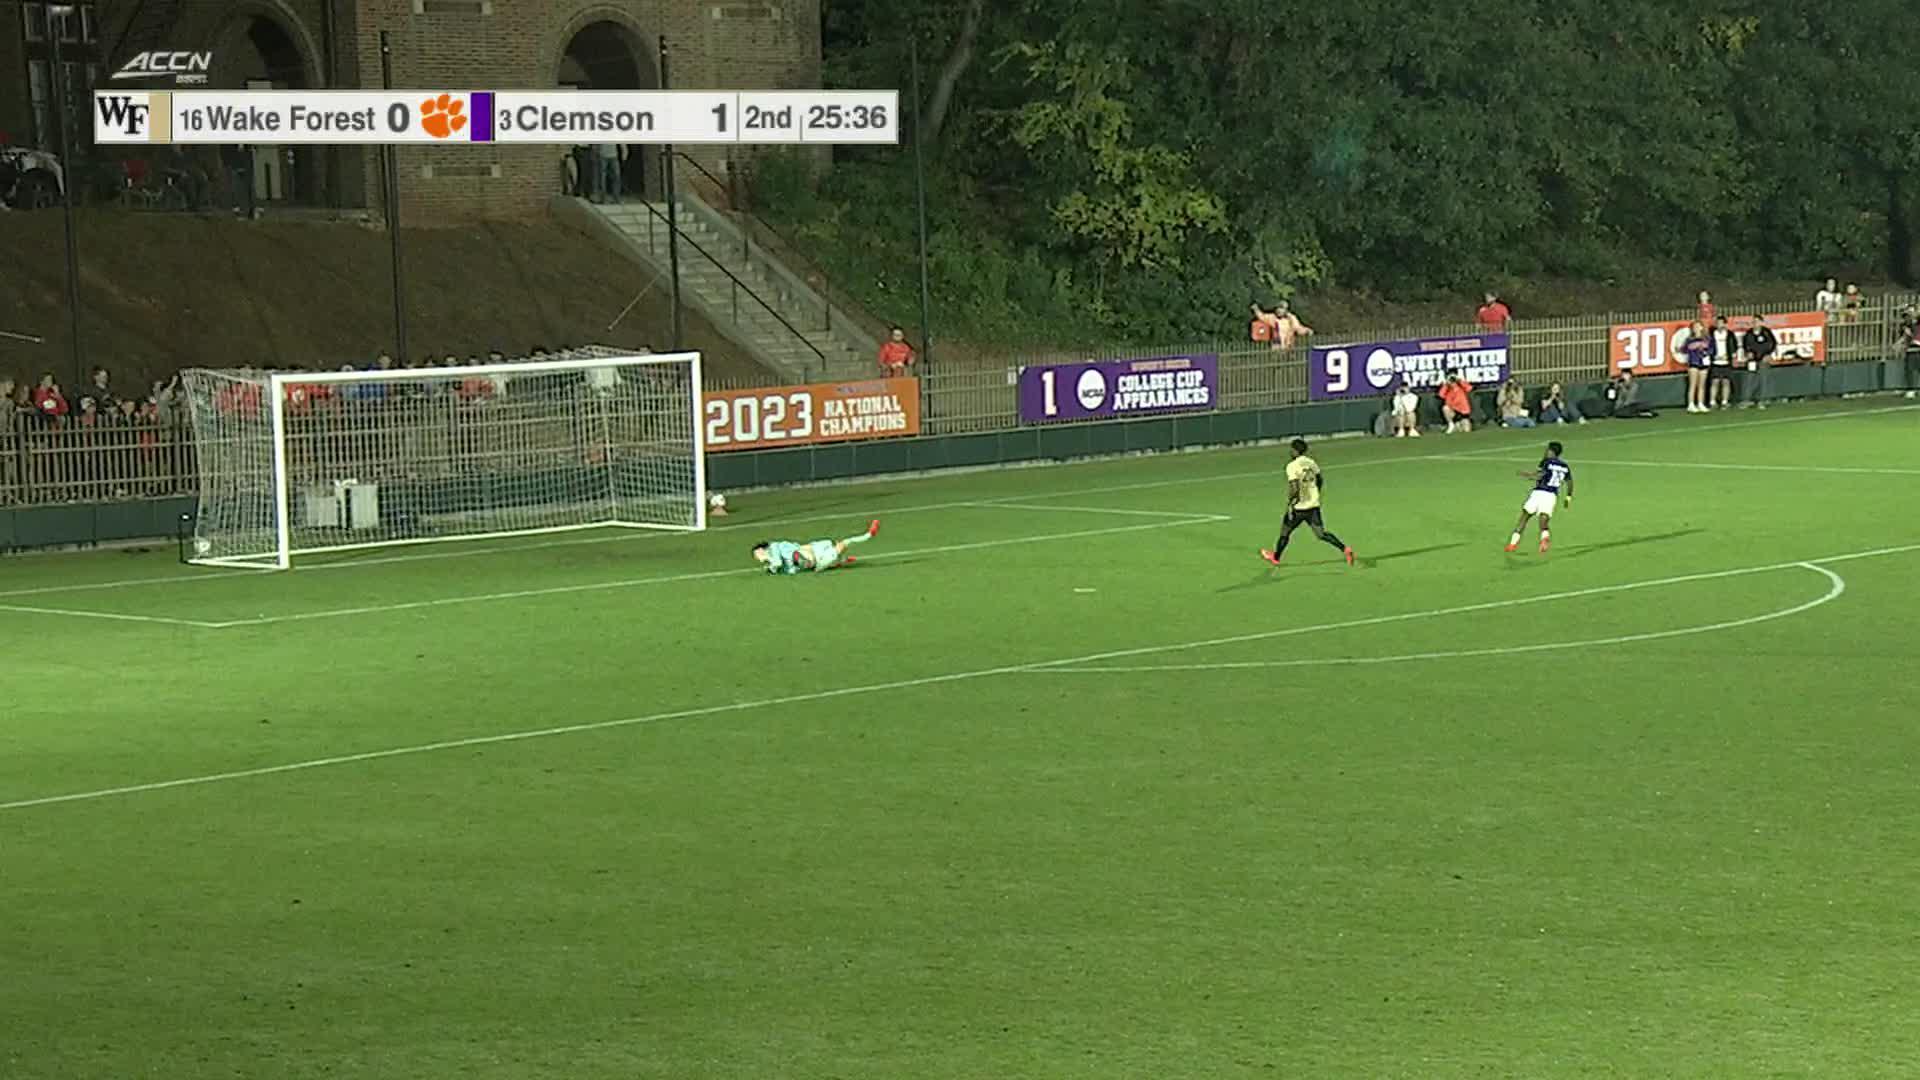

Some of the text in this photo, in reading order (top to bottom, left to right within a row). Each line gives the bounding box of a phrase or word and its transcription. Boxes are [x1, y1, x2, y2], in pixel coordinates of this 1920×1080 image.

[1616, 328, 1665, 369] 30
[1326, 350, 1349, 392] 9
[1394, 349, 1507, 373] SWEET SIXTEEN
[1117, 370, 1204, 393] COLLEGE CUP
[1402, 366, 1500, 388] APPEAANCES
[1041, 371, 1057, 416] 1
[1113, 387, 1209, 411] APPEARANCES
[823, 395, 902, 417] NATIONAL
[706, 393, 813, 444] 2023
[819, 412, 906, 437] CHAMPIONS
